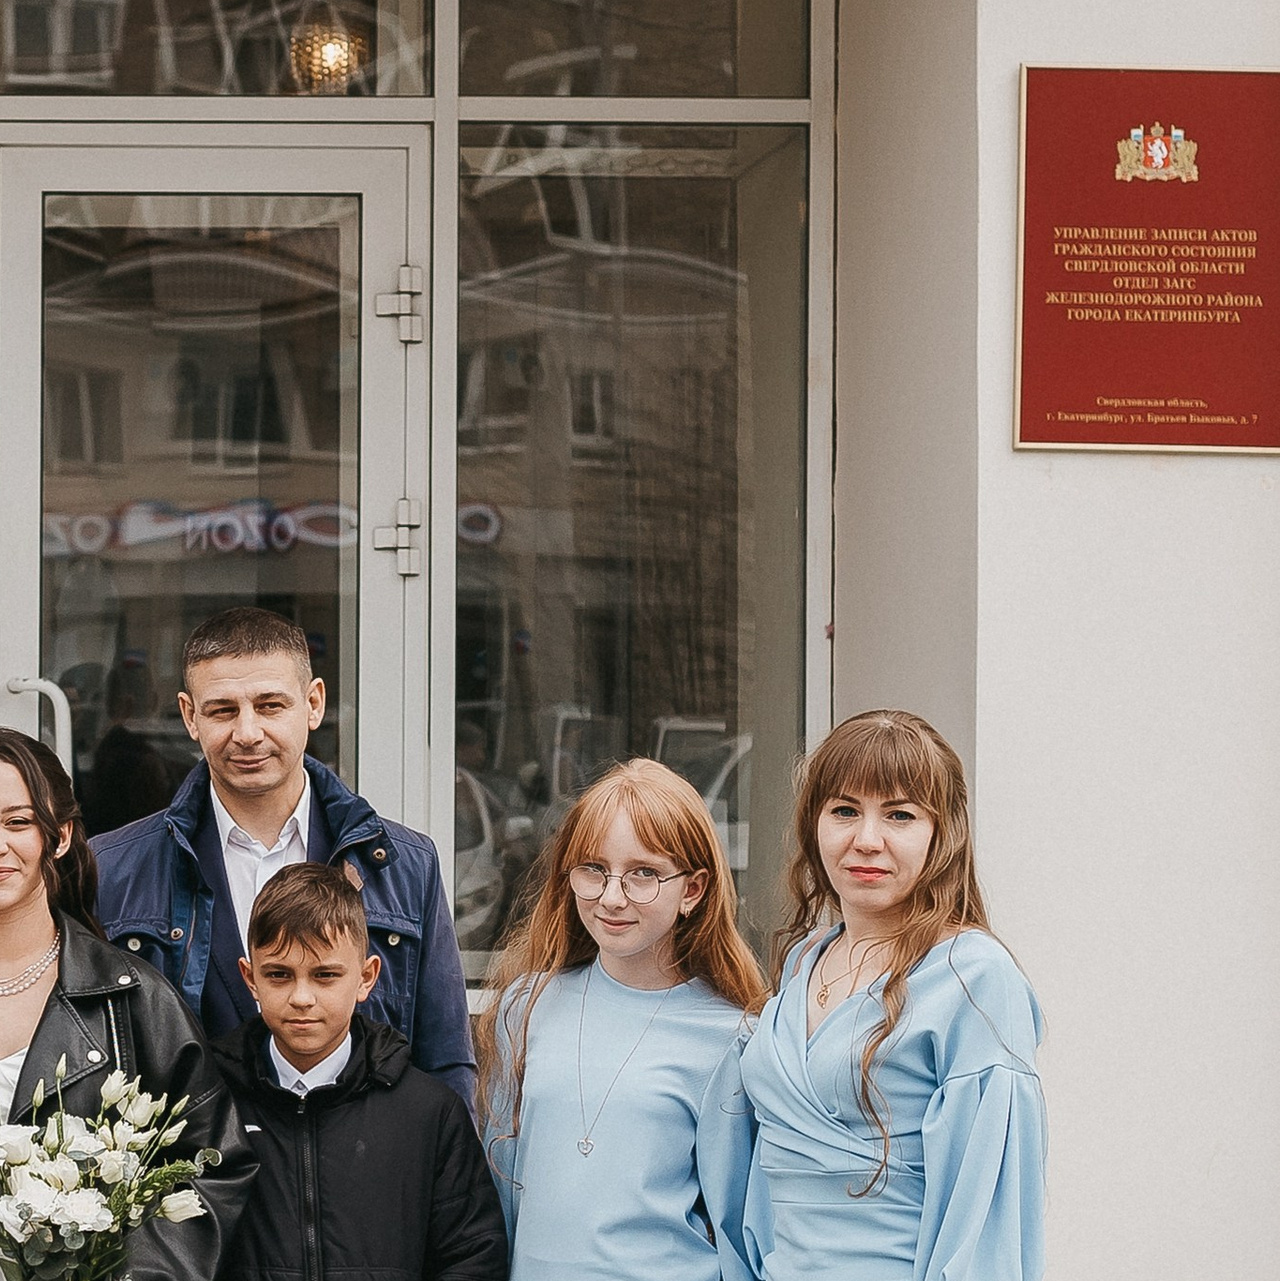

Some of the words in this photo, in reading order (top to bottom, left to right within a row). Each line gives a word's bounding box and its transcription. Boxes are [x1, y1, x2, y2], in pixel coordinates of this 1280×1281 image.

[1053, 226, 1148, 241] УПРАВЛЕНИЕ
[1151, 228, 1208, 242] ЗАПИСИ
[1211, 229, 1258, 243] АКТОВ
[1053, 243, 1168, 257] ГРАЖДАНСКОГО
[1171, 245, 1257, 259] СОСТОЯНИЯ
[1064, 258, 1177, 274] СВЕРДЛОВСКОЙ
[1180, 261, 1245, 275] ОБЛАСТИ
[1112, 276, 1159, 290] ОТДЕЛ
[1163, 277, 1196, 290] ЗАГС
[1045, 291, 1203, 307] ЖЕЛЕЗНОДОРОЖНОГО
[1206, 291, 1264, 308] РАЙОНА
[1067, 308, 1121, 322] ГОРОДА
[1124, 309, 1241, 323] ЕКАТЕРИНБУРГА
[1096, 396, 1165, 408] Свердловская
[1167, 397, 1208, 409] область,
[1147, 412, 1187, 424] Братьев
[1251, 413, 1259, 424] 7
